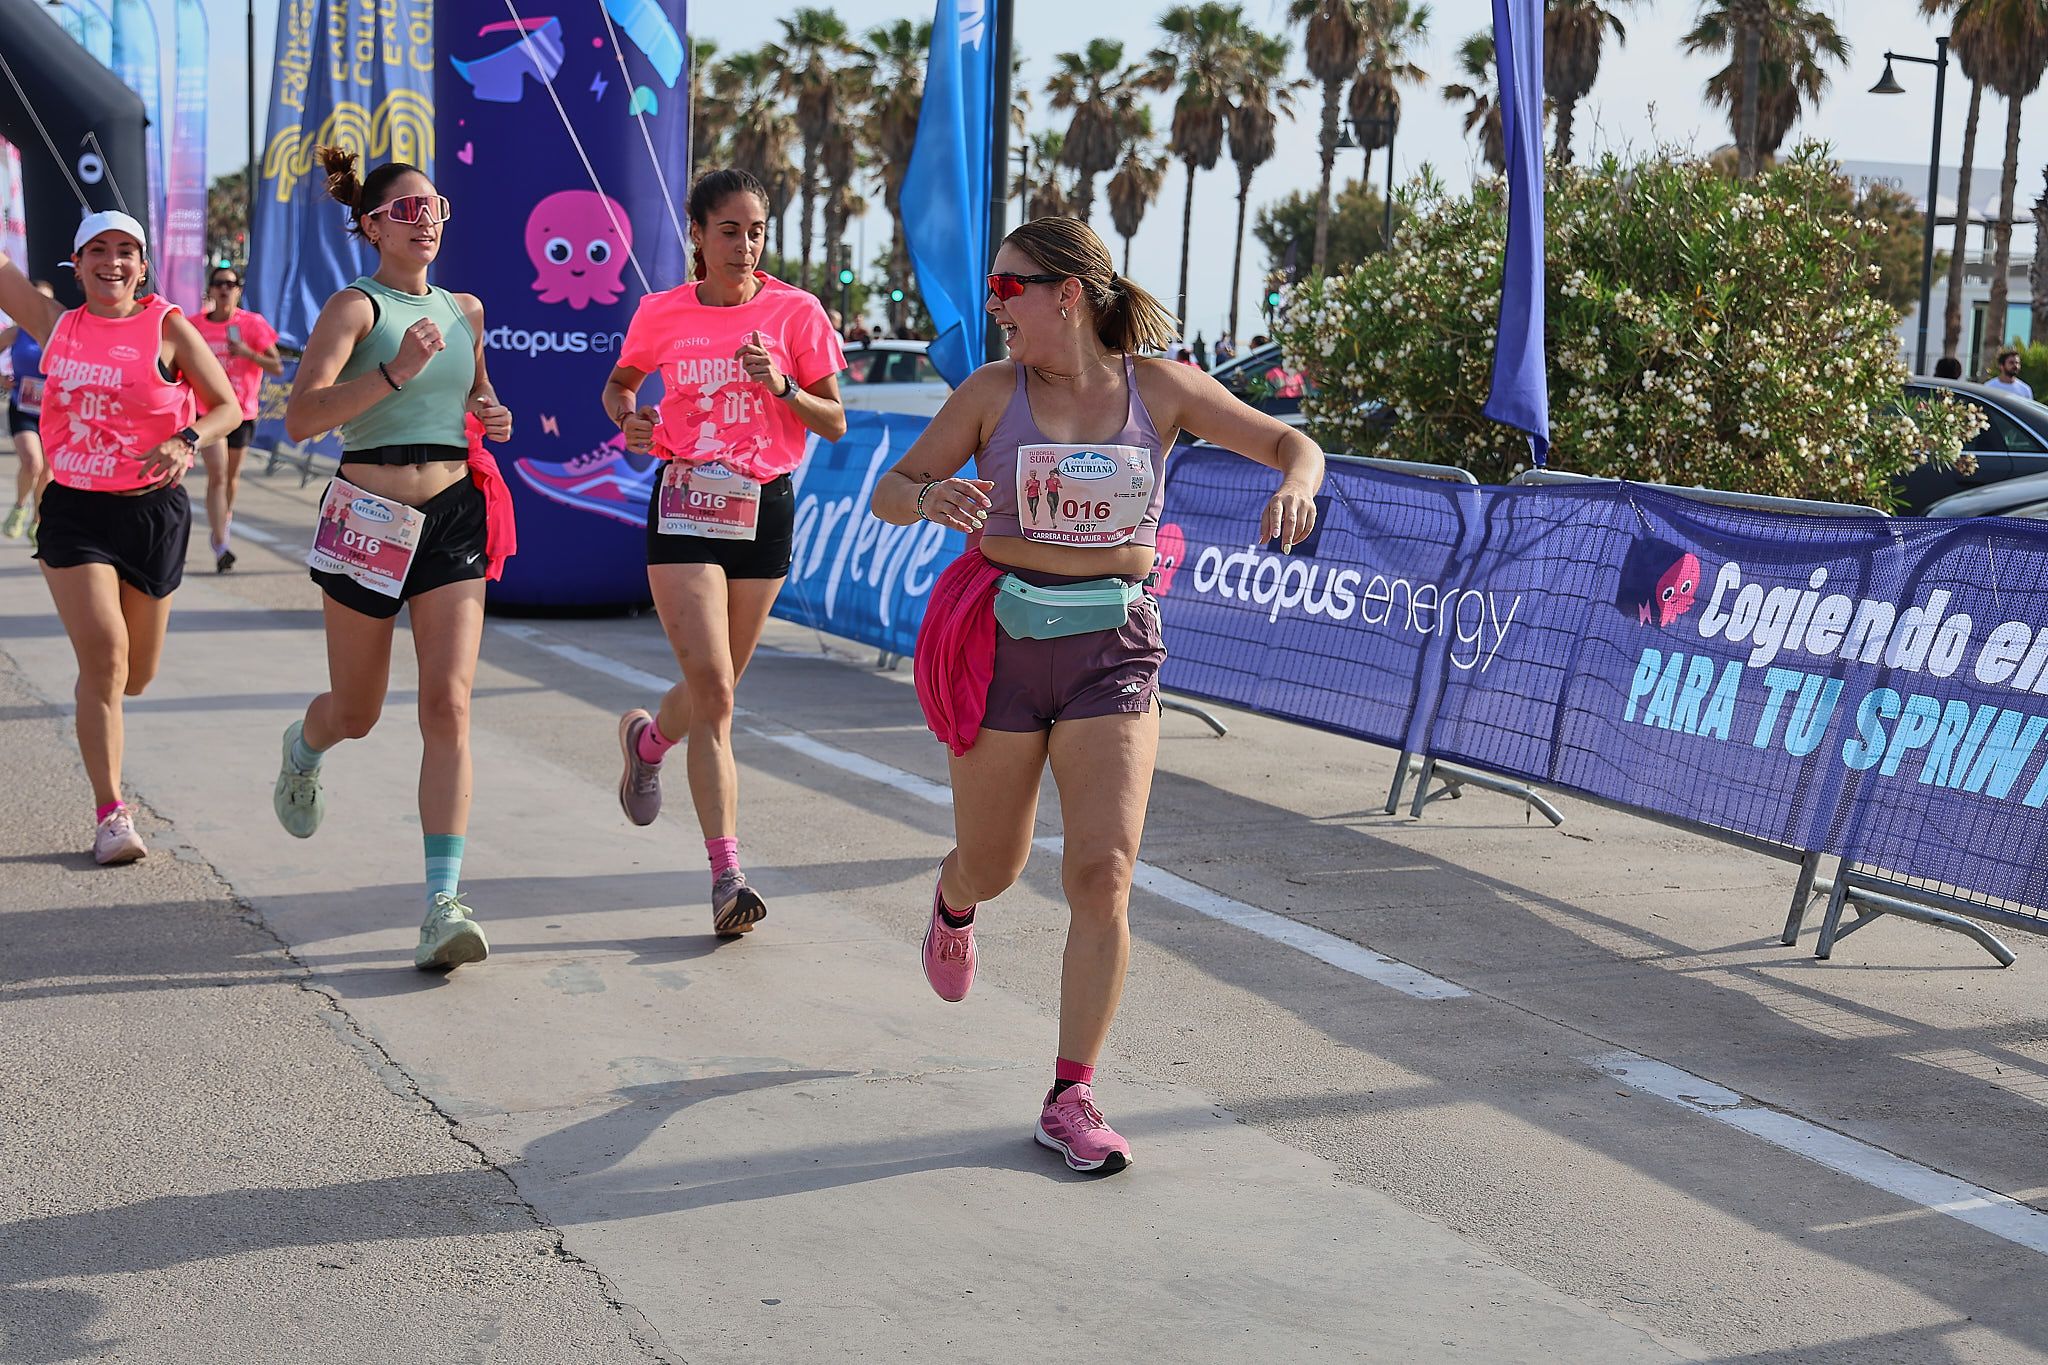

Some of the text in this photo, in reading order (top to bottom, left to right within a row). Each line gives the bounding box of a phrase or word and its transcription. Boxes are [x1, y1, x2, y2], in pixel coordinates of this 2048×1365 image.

[674, 336, 710, 350] OYSHO
[677, 357, 753, 385] CARRE
[80, 391, 109, 421] DE
[723, 391, 751, 424] DE
[54, 449, 117, 478] MUJER
[1030, 455, 1056, 464] SUMA
[1062, 461, 1113, 474] ASTURIANA
[689, 491, 727, 509] 016
[1062, 499, 1111, 520] 016
[666, 521, 697, 531] OYSHO
[789, 423, 948, 628] arlene
[1032, 531, 1061, 541] CARRERA
[1080, 535, 1102, 543] MUJER
[1074, 523, 1097, 533] 4037
[343, 529, 381, 555] 016
[1193, 544, 1521, 673] octopus energy
[1698, 561, 1973, 677] Cogiendo
[1623, 647, 1743, 741] PARA
[1752, 667, 1845, 757] TU
